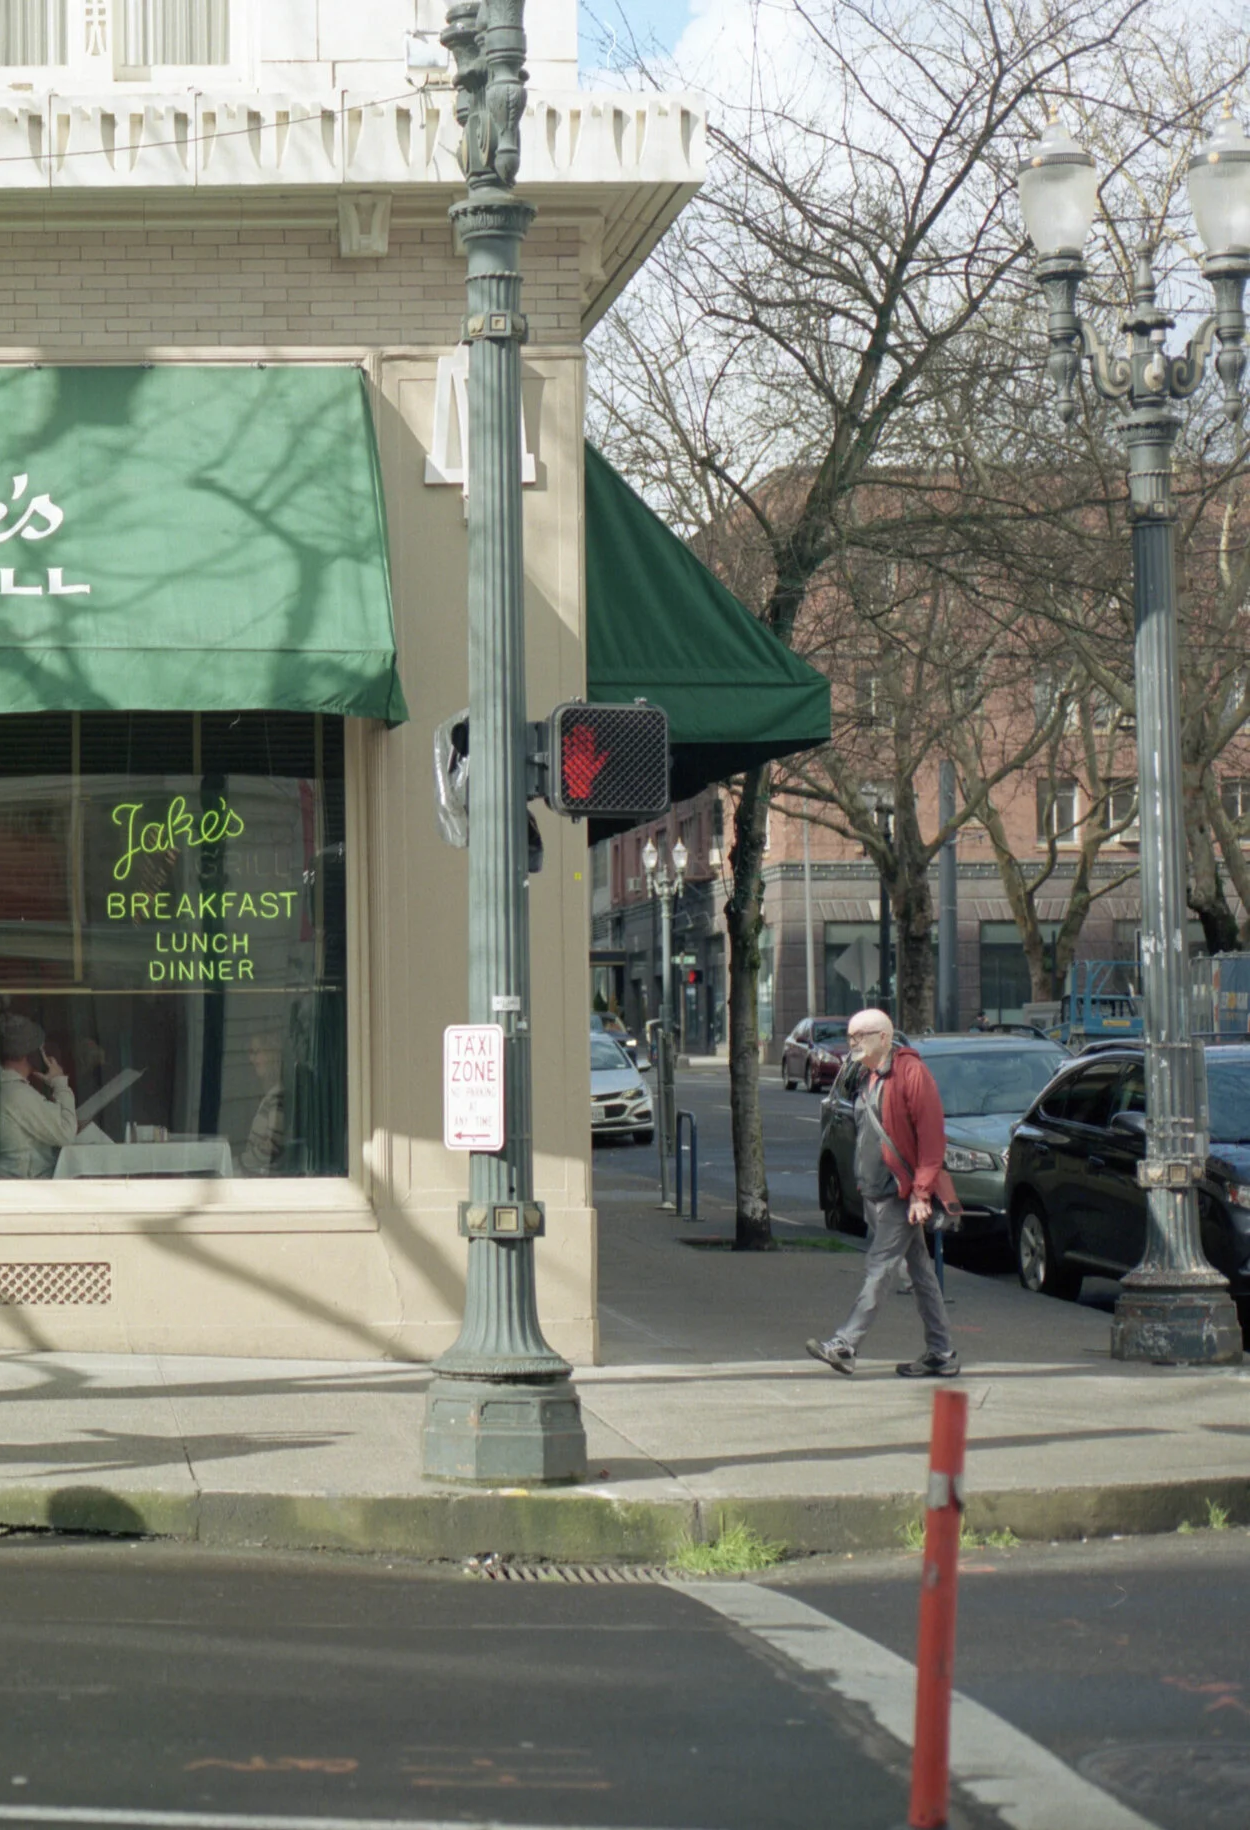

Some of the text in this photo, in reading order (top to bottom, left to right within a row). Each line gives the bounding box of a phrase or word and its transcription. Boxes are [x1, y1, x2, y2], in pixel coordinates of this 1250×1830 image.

[111, 796, 245, 880] Jake's
[107, 891, 298, 919] BREAKFAST
[156, 932, 249, 953] LUNCH
[149, 959, 255, 981] DINNER
[454, 1035, 492, 1056] TAXI
[452, 1061, 496, 1082] ZONE
